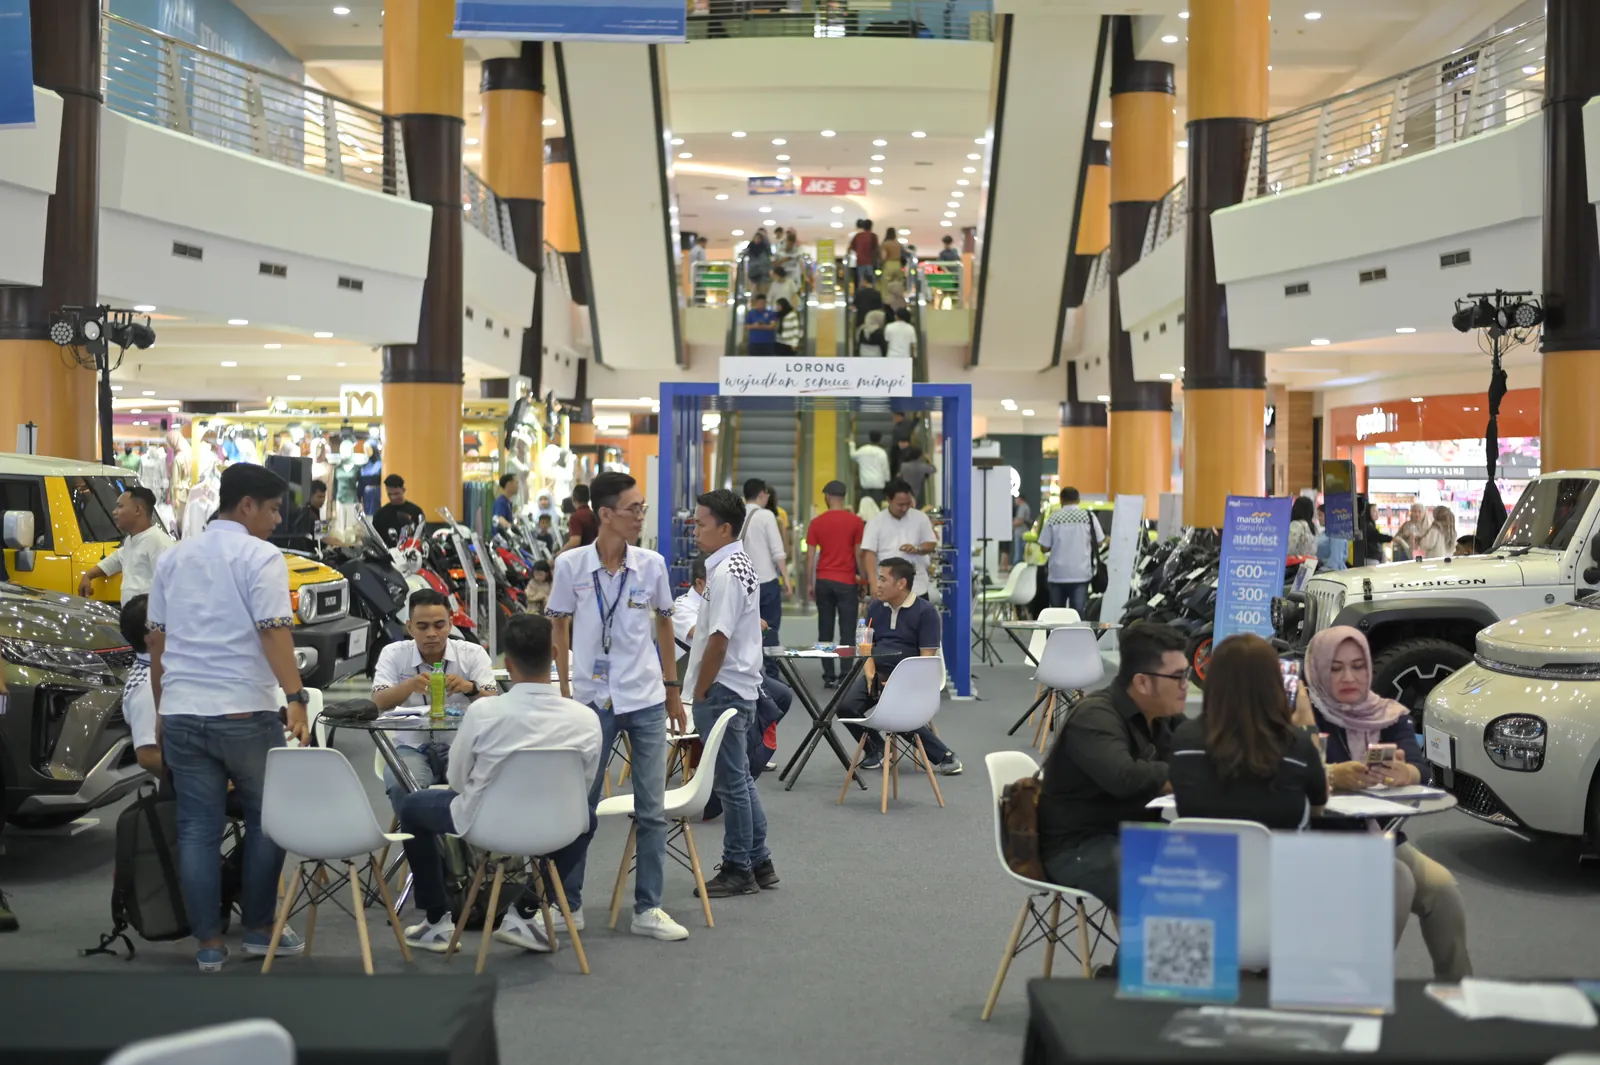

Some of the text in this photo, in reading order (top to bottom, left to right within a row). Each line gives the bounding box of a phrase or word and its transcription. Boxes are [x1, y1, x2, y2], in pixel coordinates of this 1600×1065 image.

[805, 179, 837, 193] ACE
[786, 363, 845, 372] LORONG
[725, 373, 905, 394] wujudkan semua mimpi
[1233, 533, 1278, 546] autofest
[1392, 578, 1486, 588] RUBICON
